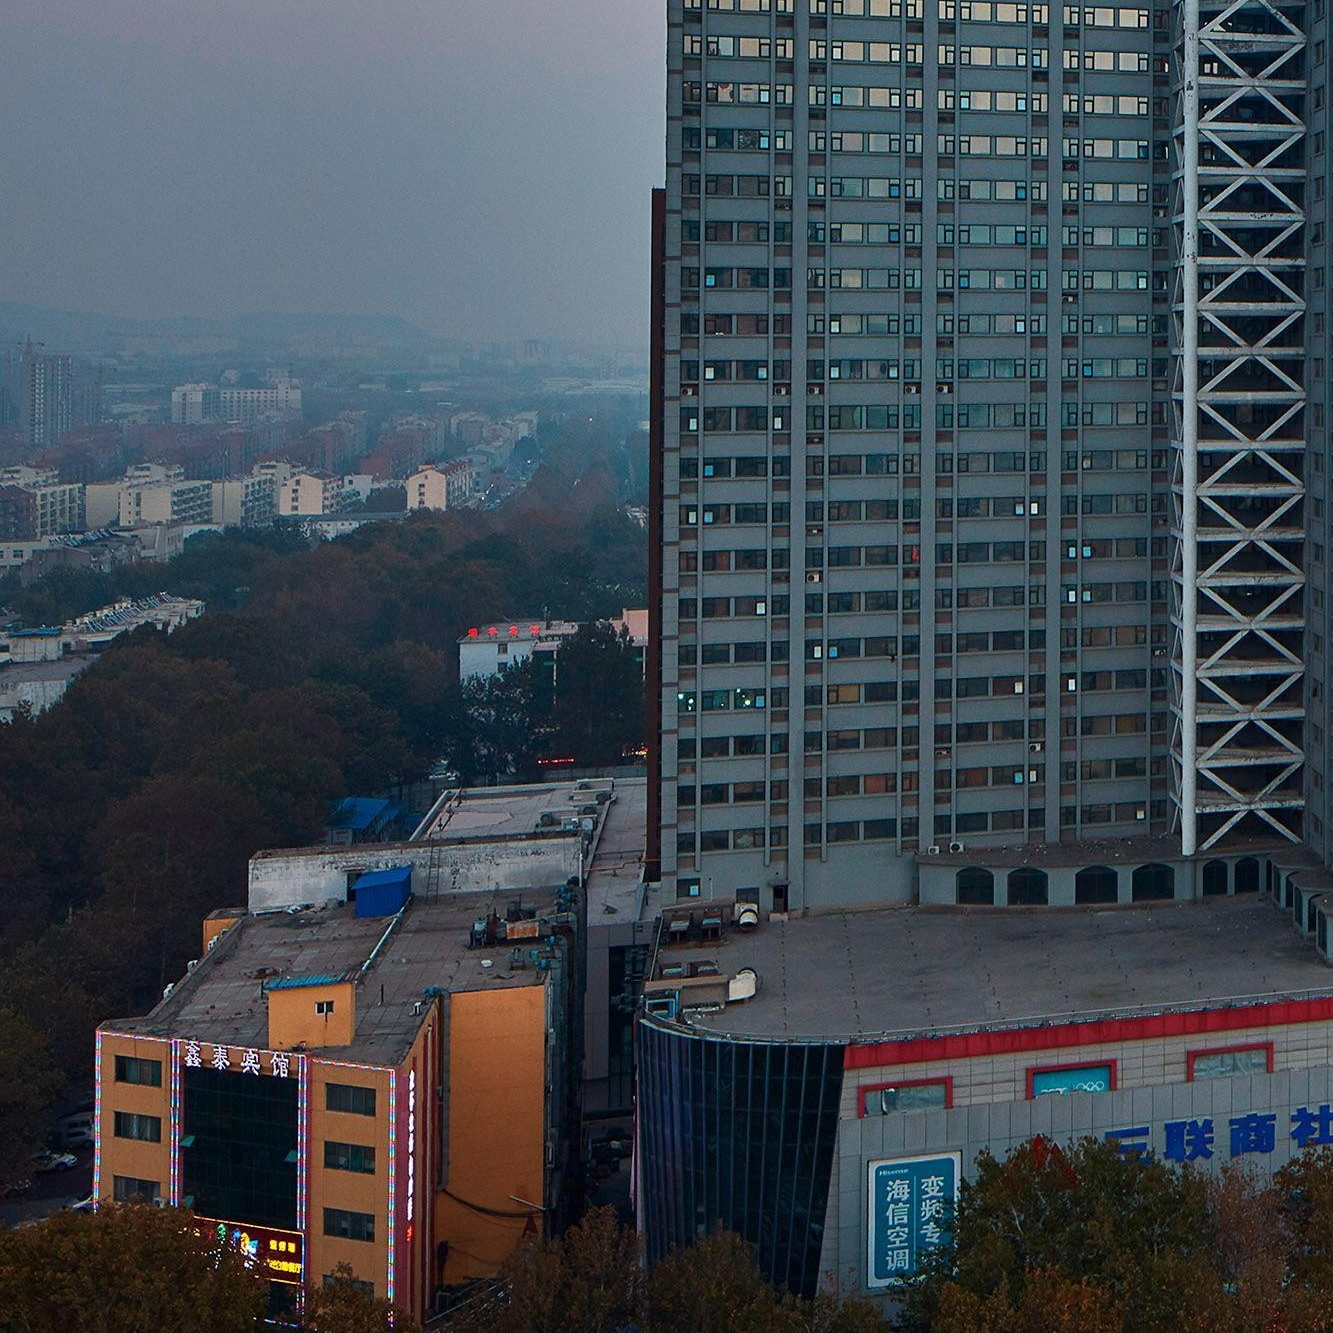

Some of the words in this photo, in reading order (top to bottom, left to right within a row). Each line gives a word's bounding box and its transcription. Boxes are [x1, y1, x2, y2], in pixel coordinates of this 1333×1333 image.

[184, 1041, 289, 1078] 鑫泰宾馆
[886, 1179, 911, 1271] 海信空调
[920, 1175, 945, 1264] 变频专
